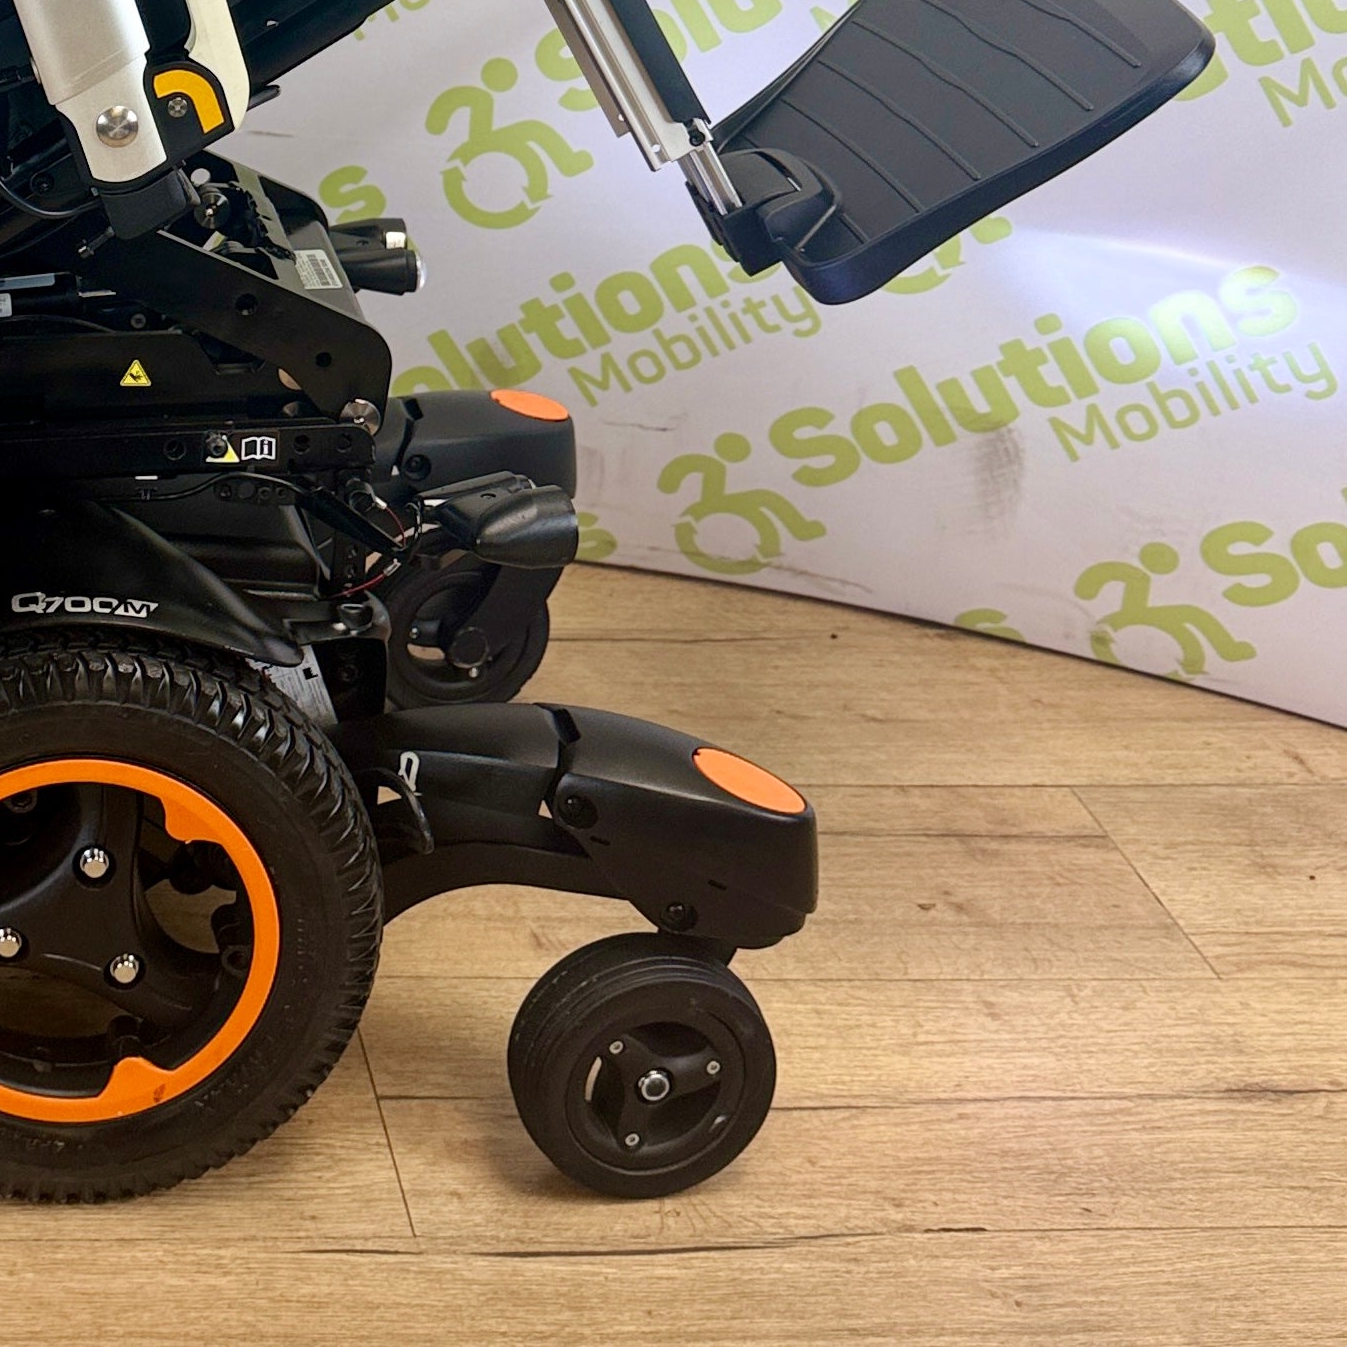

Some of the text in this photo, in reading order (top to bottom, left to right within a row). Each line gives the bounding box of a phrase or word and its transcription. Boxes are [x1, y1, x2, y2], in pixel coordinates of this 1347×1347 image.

[568, 285, 821, 407] Mobility
[767, 265, 1299, 488] Solutions
[1048, 342, 1338, 463] Mobility
